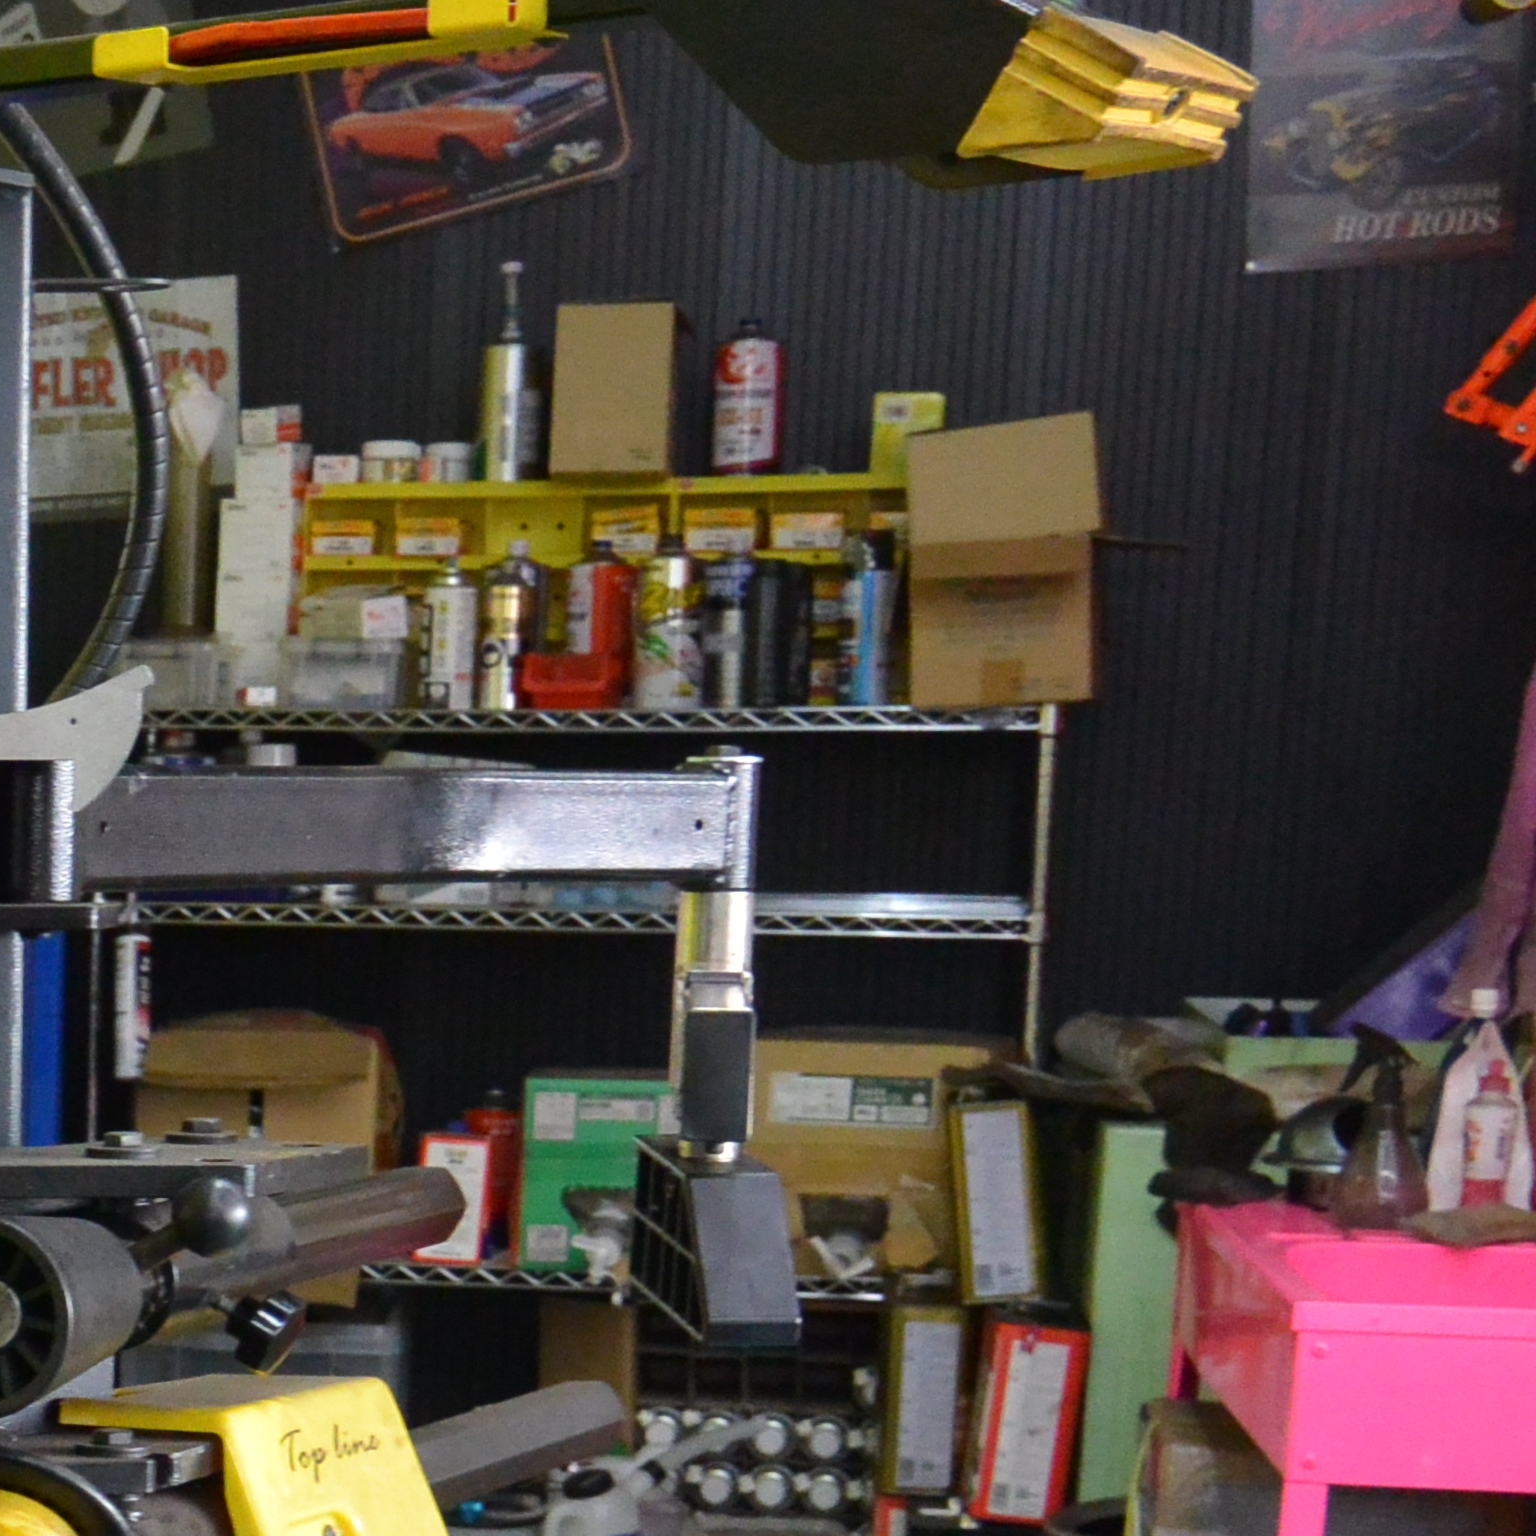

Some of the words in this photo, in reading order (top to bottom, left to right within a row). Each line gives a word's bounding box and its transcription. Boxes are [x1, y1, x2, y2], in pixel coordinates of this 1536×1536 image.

[1333, 211, 1403, 243] HOT
[1407, 205, 1503, 238] RODS
[279, 1428, 327, 1484] Top
[333, 1423, 381, 1459] line
